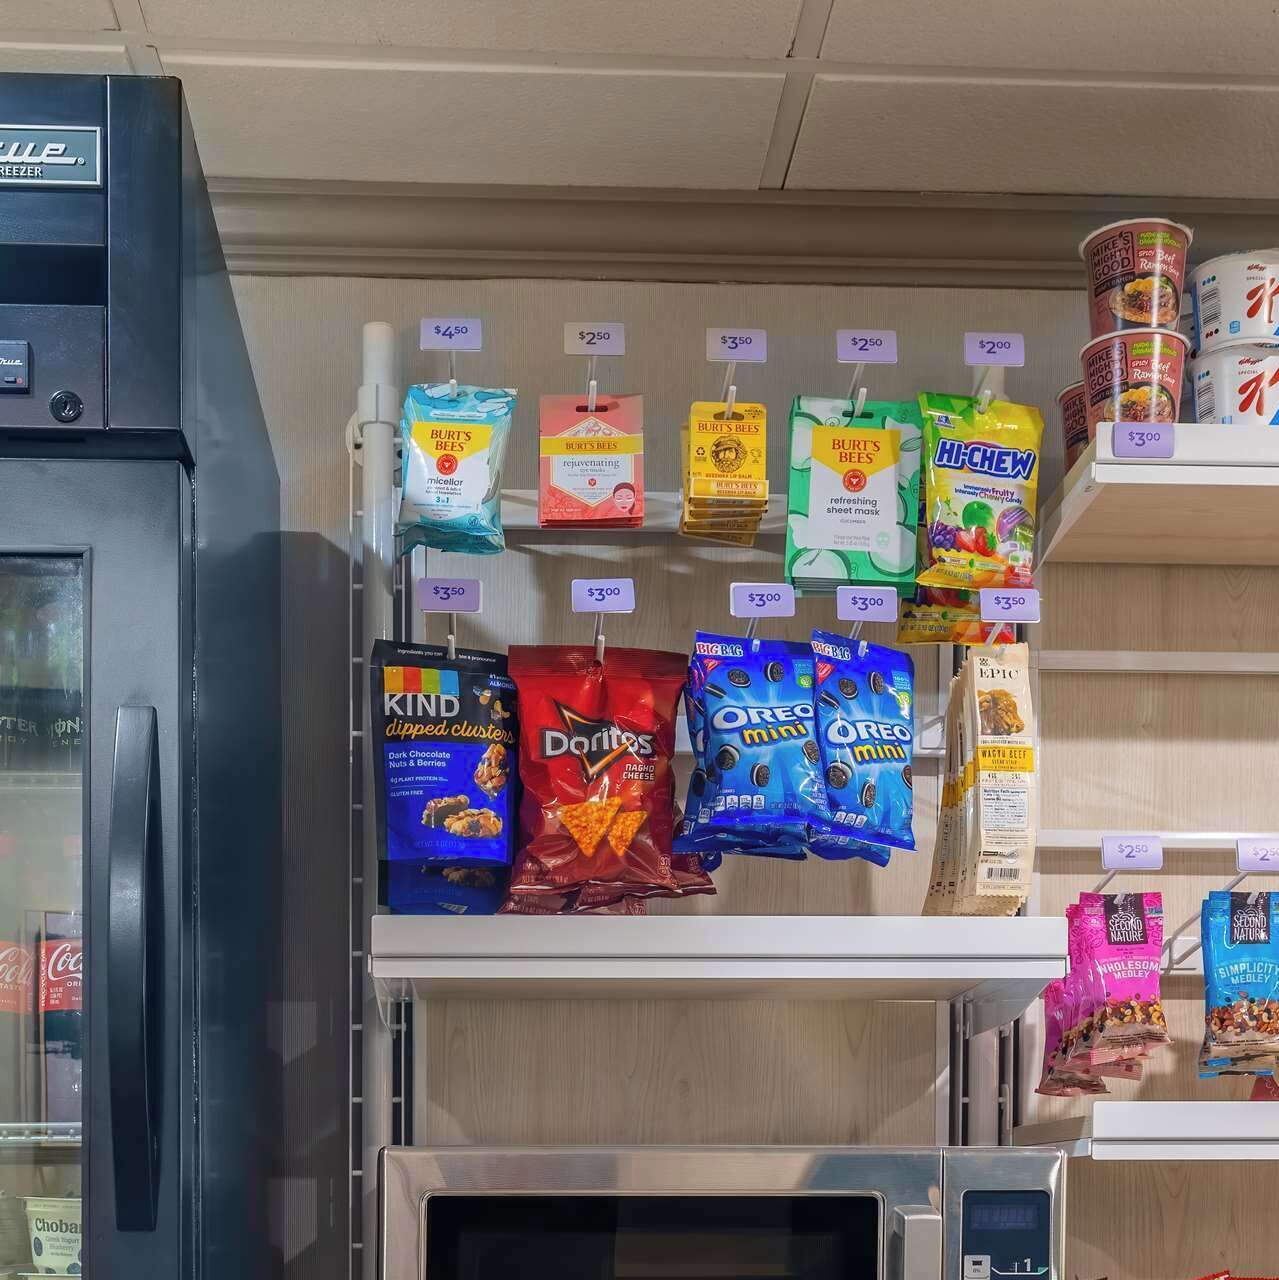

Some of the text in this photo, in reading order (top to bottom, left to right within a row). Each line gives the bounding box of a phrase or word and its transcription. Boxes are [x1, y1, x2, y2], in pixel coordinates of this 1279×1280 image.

[1092, 232, 1130, 258] MIKE'S
[1094, 246, 1130, 269] MIGHTY
[1094, 257, 1131, 281] GOOD
[431, 429, 472, 441] BURT'S
[698, 424, 759, 433] BURT'S BEES
[435, 441, 465, 451] BEES
[565, 442, 617, 450] BURT'S BEES
[832, 438, 880, 452] BURT'S
[563, 458, 620, 468] rejuvenating
[839, 451, 874, 464] BEES
[934, 438, 1036, 480] HI-CHEW
[830, 496, 877, 508] refreshing
[826, 506, 880, 517] sheet mask
[696, 642, 744, 657] BIG BAG
[384, 693, 460, 717] KIND
[712, 705, 814, 729] OREO
[386, 718, 514, 744] dipped clusters
[742, 721, 808, 746] mini
[543, 726, 655, 759] Doritos
[389, 750, 450, 760] Dark Chocolate
[622, 771, 655, 782] CHEESE
[1108, 917, 1142, 932] SECOND
[1234, 913, 1267, 930] SECOND
[1110, 929, 1144, 944] NATURE
[1114, 968, 1150, 979] MEDLEY
[1231, 972, 1270, 985] MEDLEY
[1024, 1258, 1032, 1272] 1
